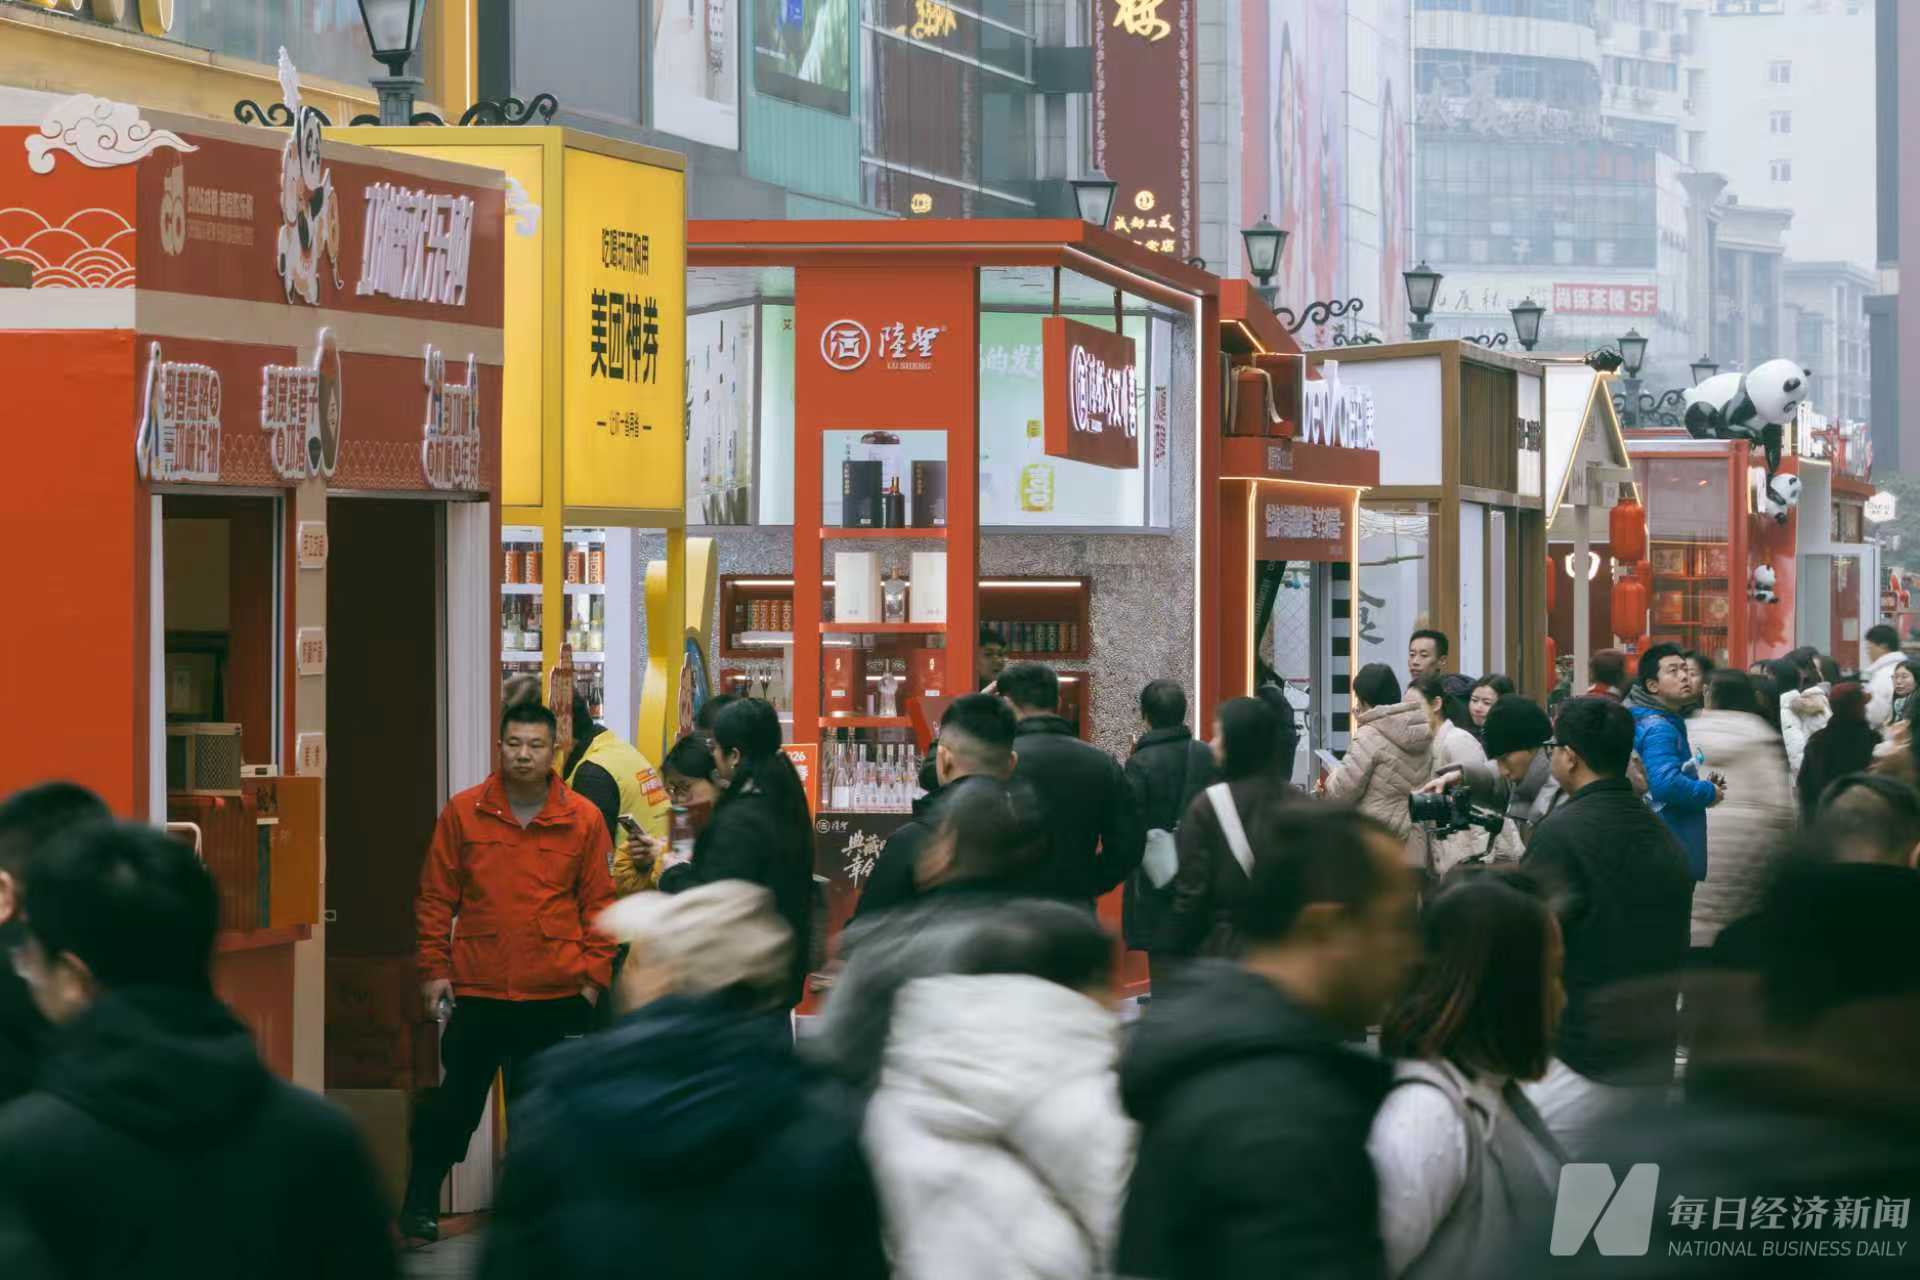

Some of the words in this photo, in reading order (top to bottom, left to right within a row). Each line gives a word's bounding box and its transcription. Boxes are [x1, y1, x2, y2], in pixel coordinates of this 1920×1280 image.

[1630, 288, 1657, 313] 5F
[590, 287, 659, 385] 美团神券
